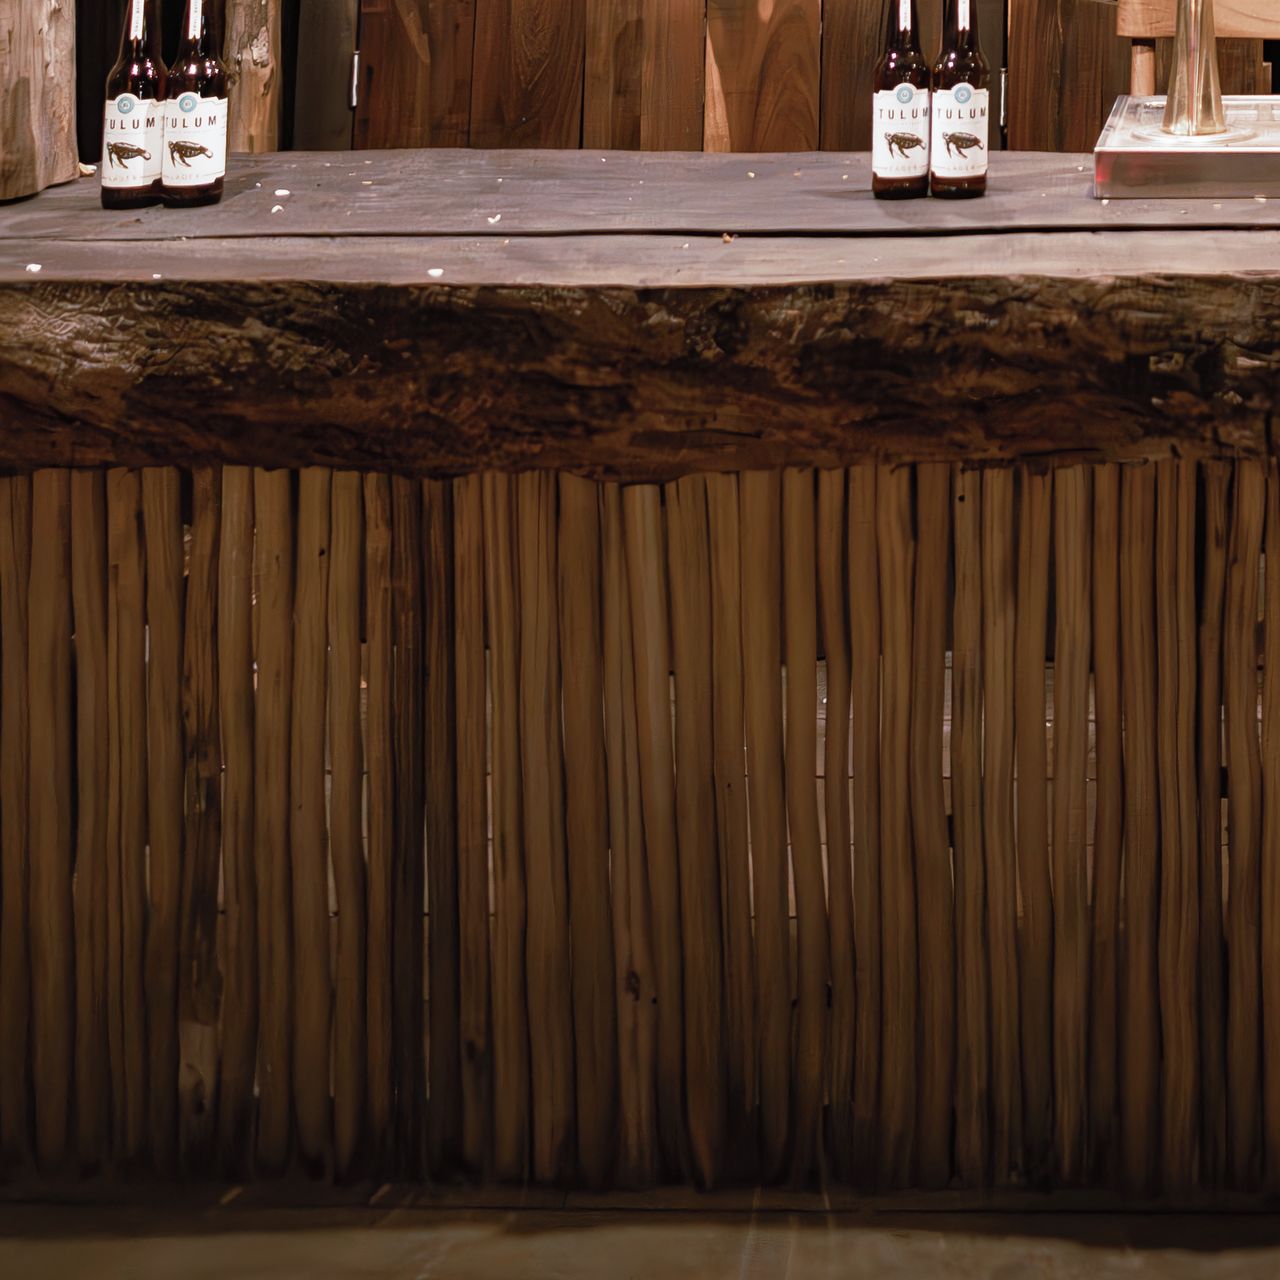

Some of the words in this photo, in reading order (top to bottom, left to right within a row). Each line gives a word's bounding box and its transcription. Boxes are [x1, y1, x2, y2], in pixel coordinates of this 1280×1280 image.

[879, 105, 929, 120] TULUM
[937, 106, 987, 119] TULUM
[105, 117, 156, 129] ULUM
